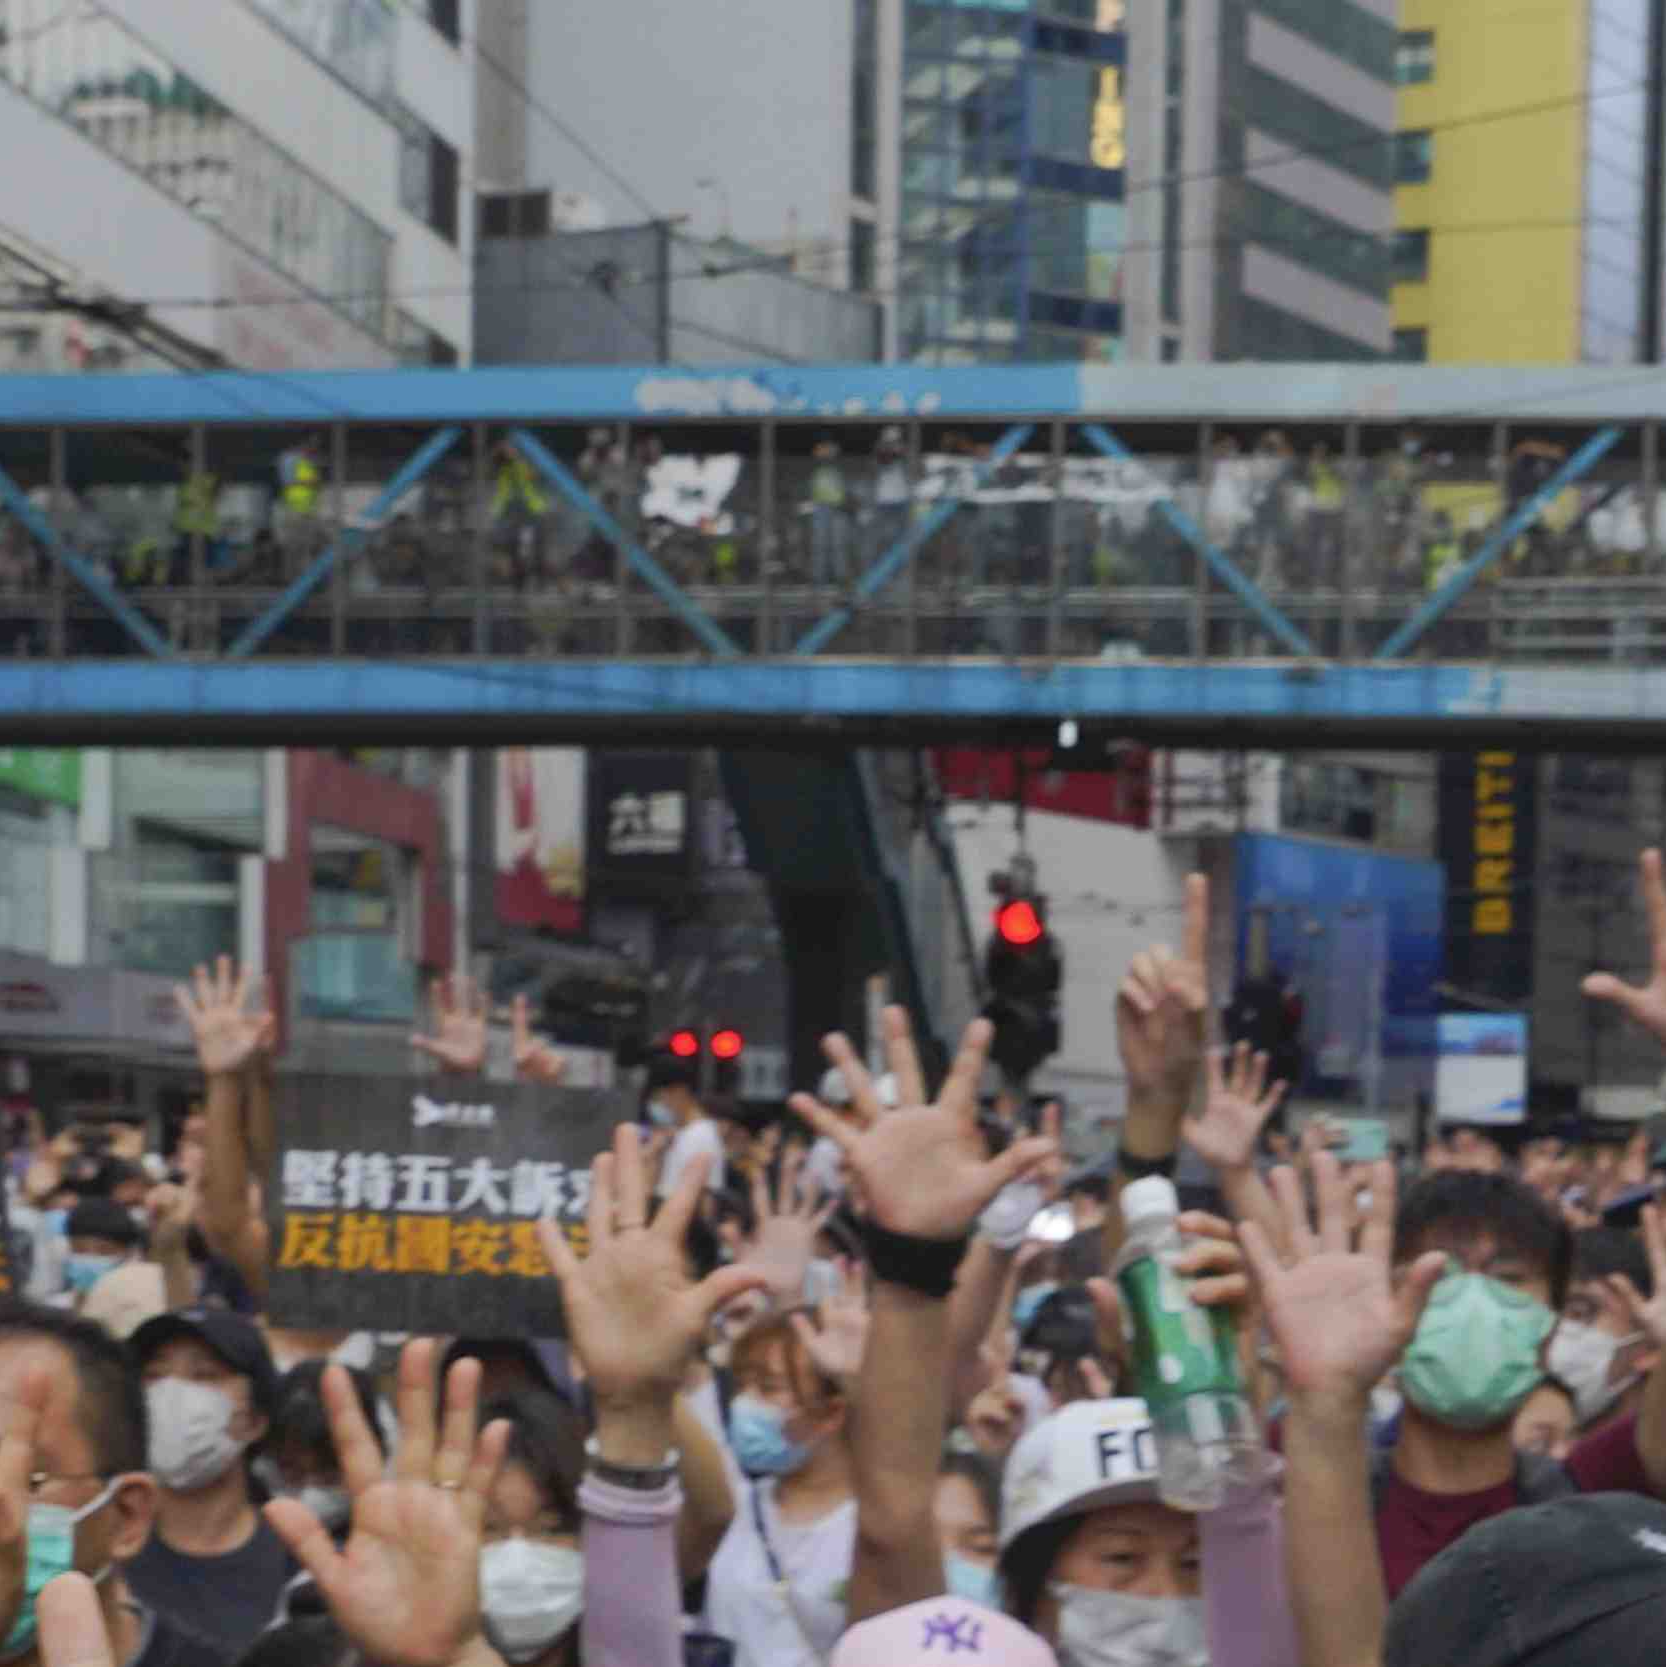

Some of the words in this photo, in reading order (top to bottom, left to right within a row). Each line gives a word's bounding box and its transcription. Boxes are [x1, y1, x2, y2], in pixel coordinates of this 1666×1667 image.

[280, 1212, 590, 1277] 反抗國安惡
